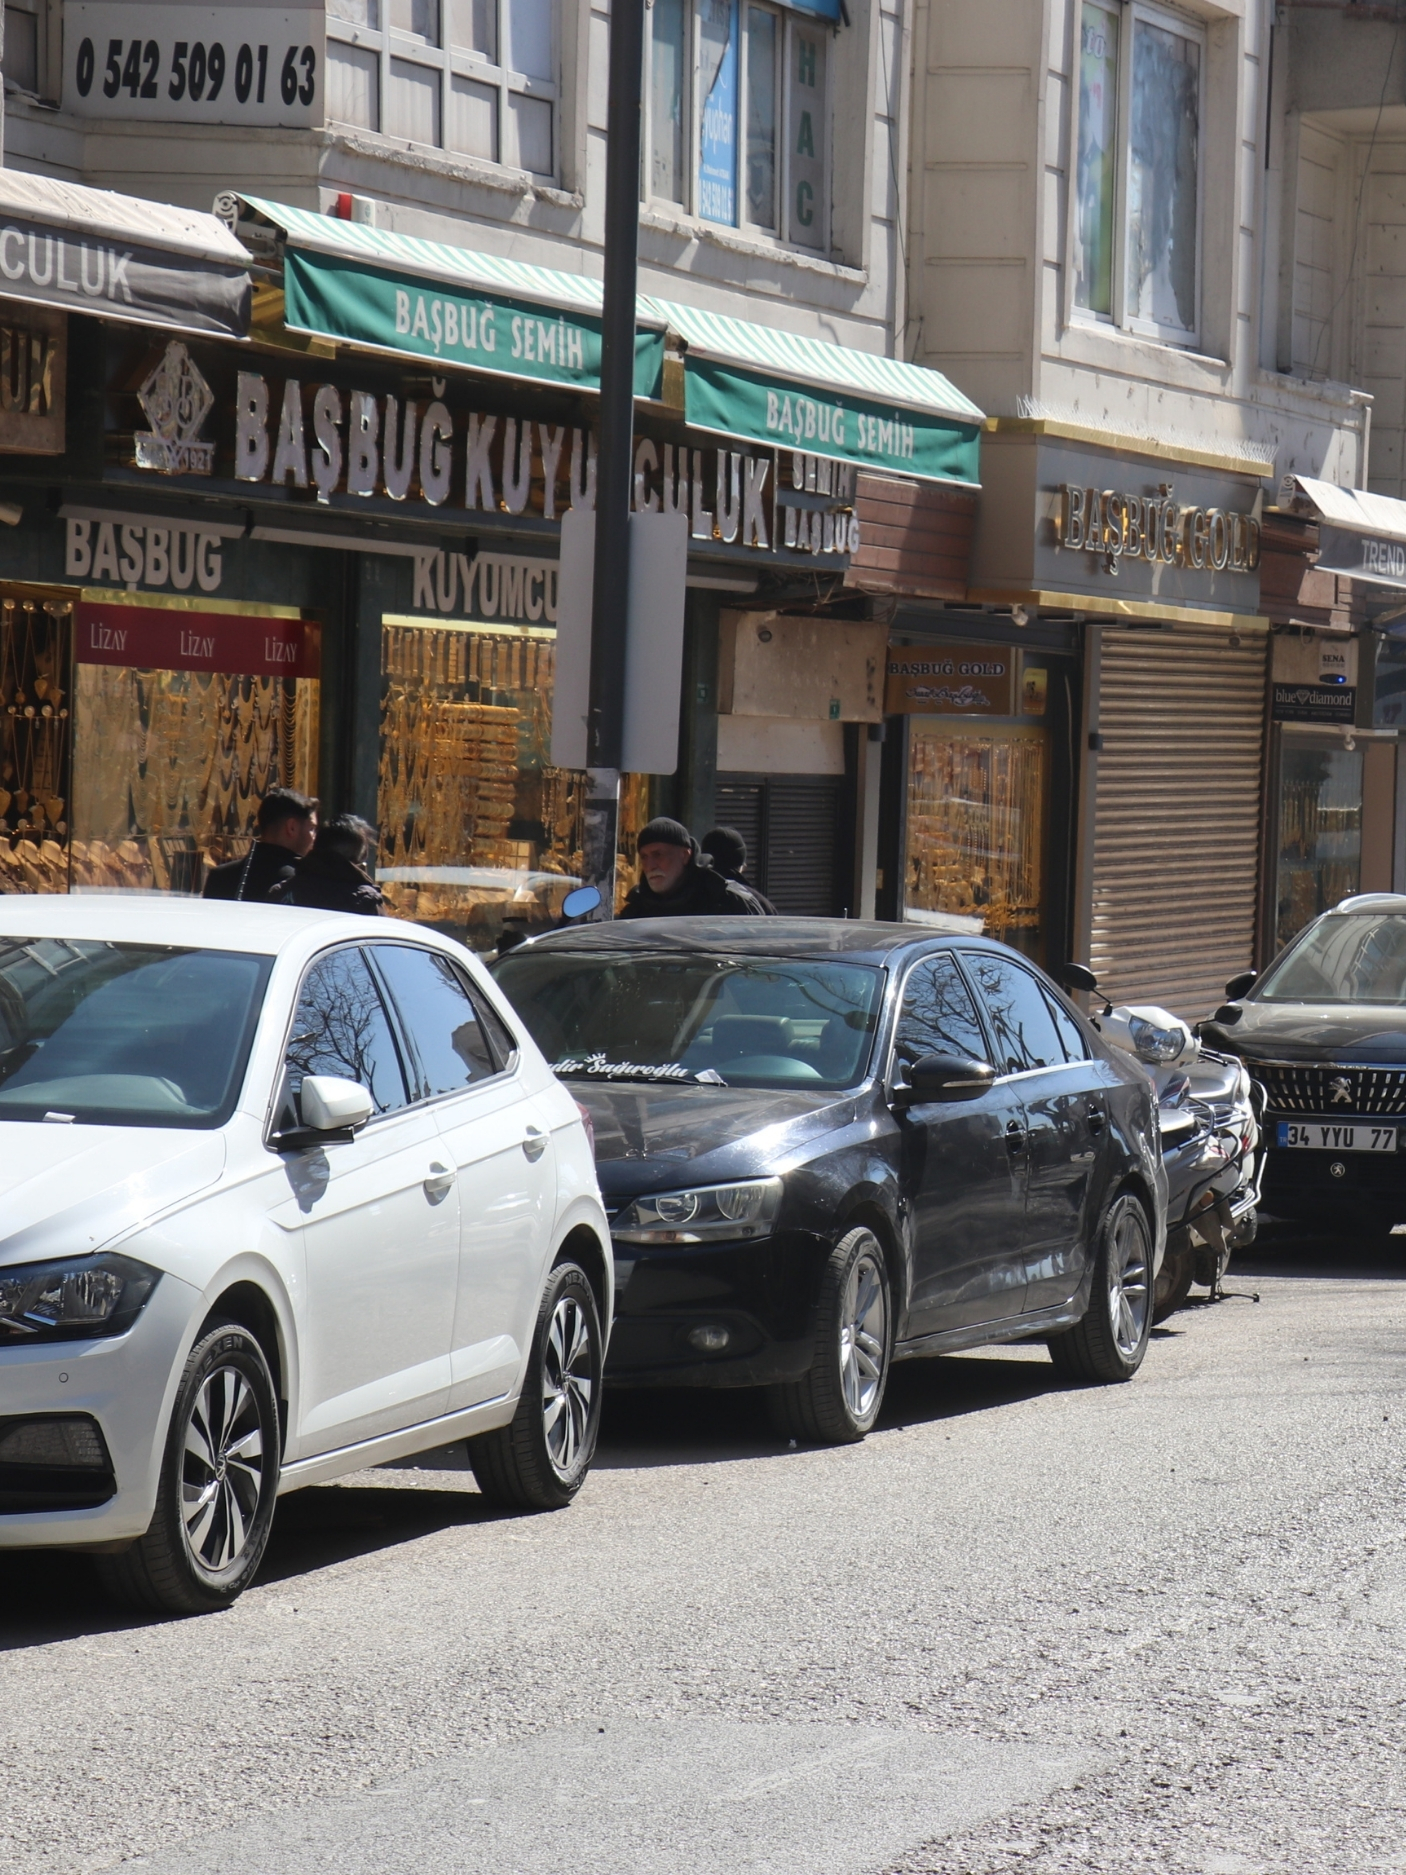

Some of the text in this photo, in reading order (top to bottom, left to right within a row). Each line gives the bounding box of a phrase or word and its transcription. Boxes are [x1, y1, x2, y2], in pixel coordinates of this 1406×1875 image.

[76, 37, 316, 106] 0 542 509 01 63
[0, 225, 133, 303] CULUK
[395, 289, 583, 370] BAŞBUĞ SEMİH
[766, 391, 914, 459] BAŞBUĞ SEMİH
[234, 370, 769, 550] BAŞBUĞ KUYUCULUK
[1059, 483, 1262, 576] BAŞBUĞ GOLD
[1361, 539, 1405, 577] TREND
[888, 659, 1005, 678] BAŞBUĞ GOLD
[1322, 654, 1346, 663] SENA
[1275, 688, 1352, 706] blue diamond
[587, 1058, 689, 1081] Sağıroğlu
[1288, 1125, 1394, 1150] 34 YYU 77
